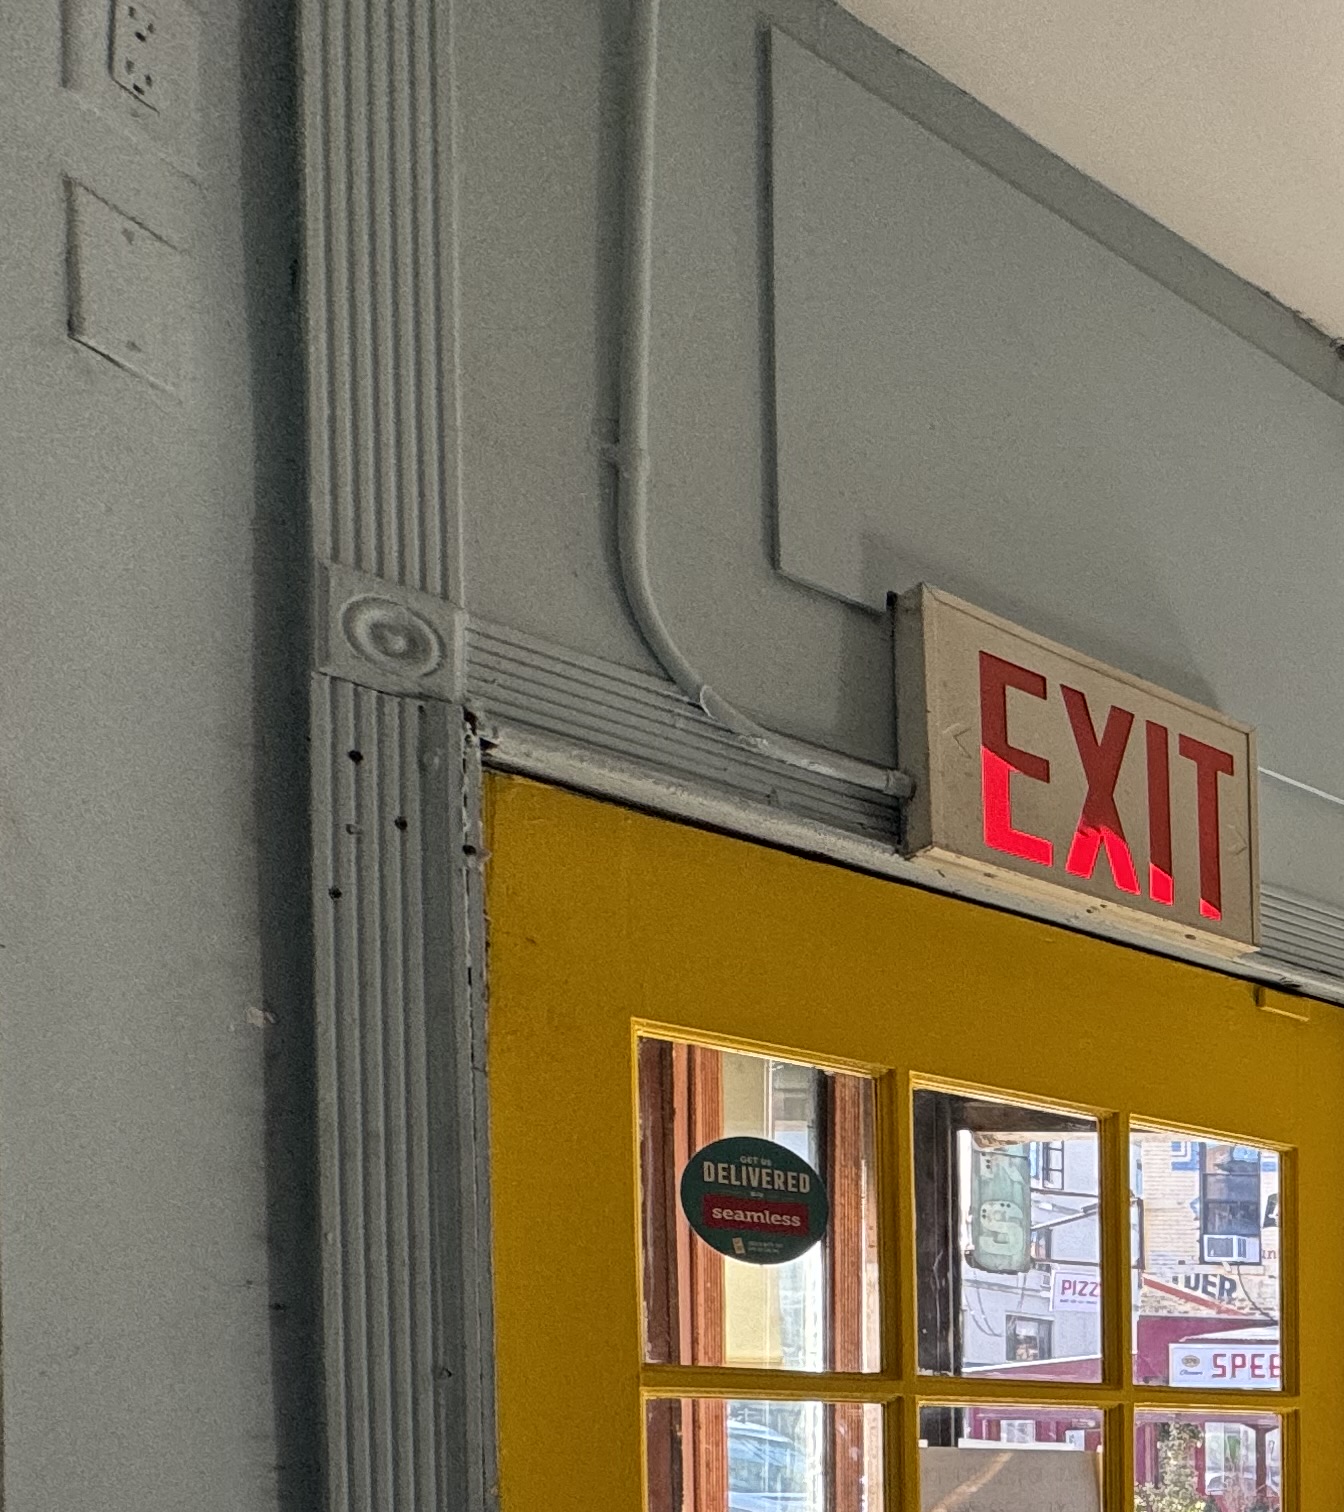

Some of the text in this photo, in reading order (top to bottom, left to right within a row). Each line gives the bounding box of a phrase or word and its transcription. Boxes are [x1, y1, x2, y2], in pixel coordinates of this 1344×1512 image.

[979, 651, 1234, 920] EXIT
[703, 1161, 811, 1194] DELIVERED
[712, 1207, 801, 1227] seamless
